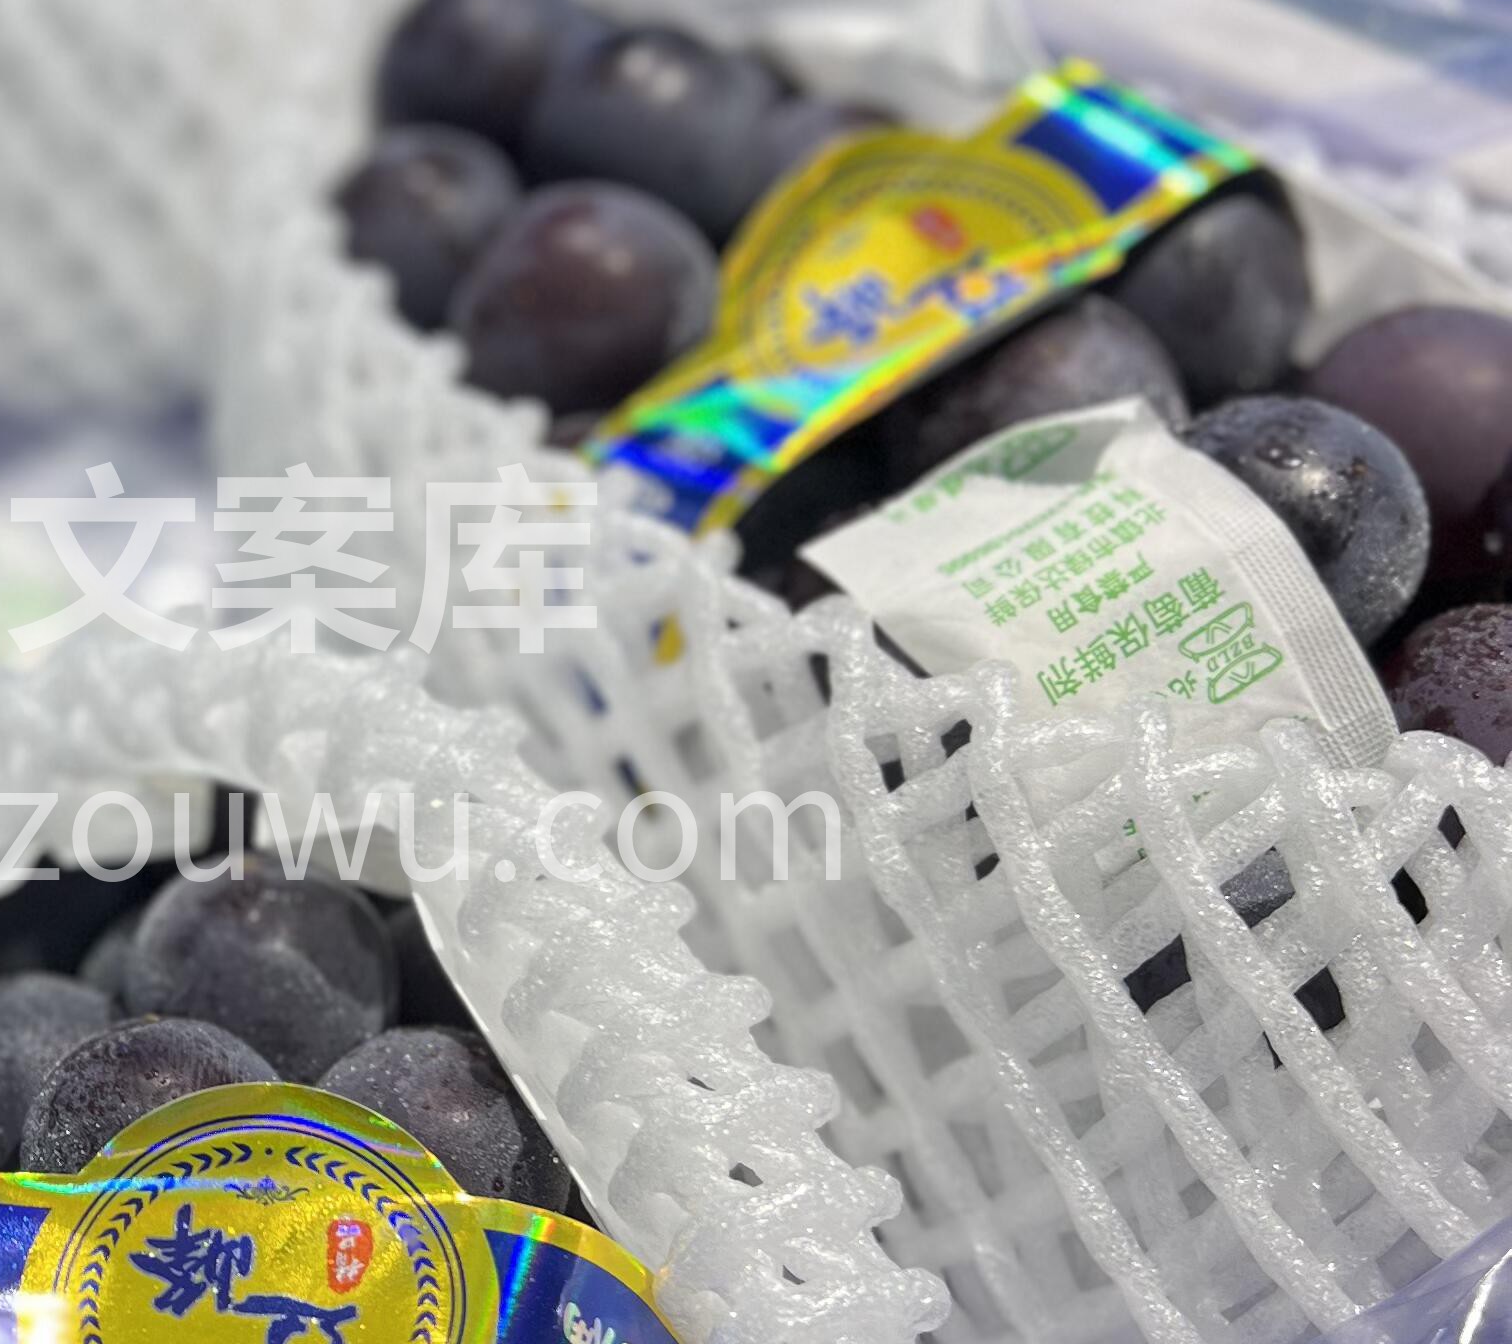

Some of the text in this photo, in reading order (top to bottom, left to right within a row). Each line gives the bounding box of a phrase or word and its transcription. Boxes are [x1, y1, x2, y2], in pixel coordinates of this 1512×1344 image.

[1048, 552, 1156, 634] 严禁食用
[1037, 568, 1225, 706] 葡萄保鲜剂
[1207, 634, 1254, 672] BZLD
